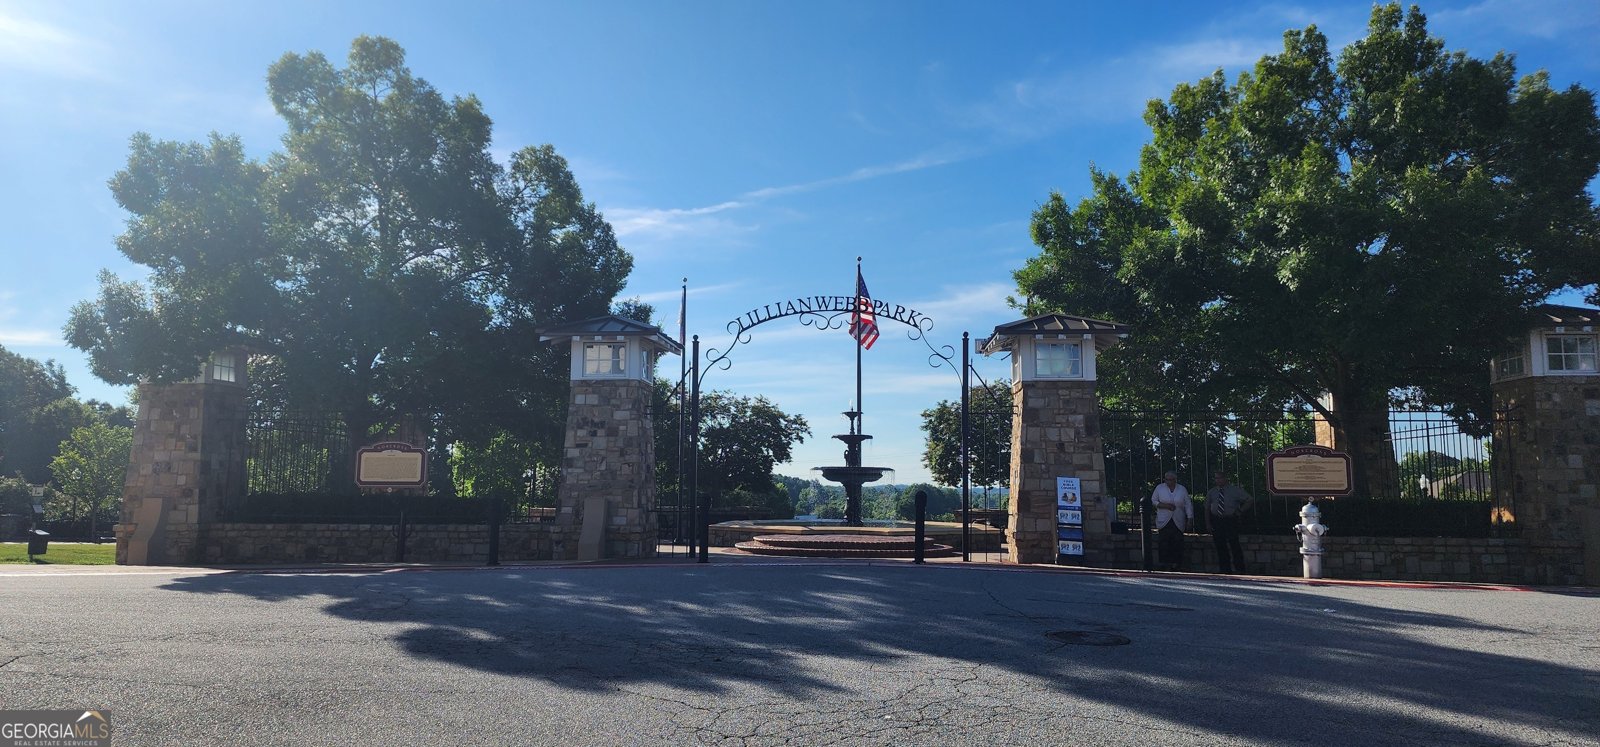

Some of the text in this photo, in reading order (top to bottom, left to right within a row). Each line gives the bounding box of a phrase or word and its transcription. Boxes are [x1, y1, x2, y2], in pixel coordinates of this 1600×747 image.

[736, 296, 923, 332] LILLIAN WEBB PARK
